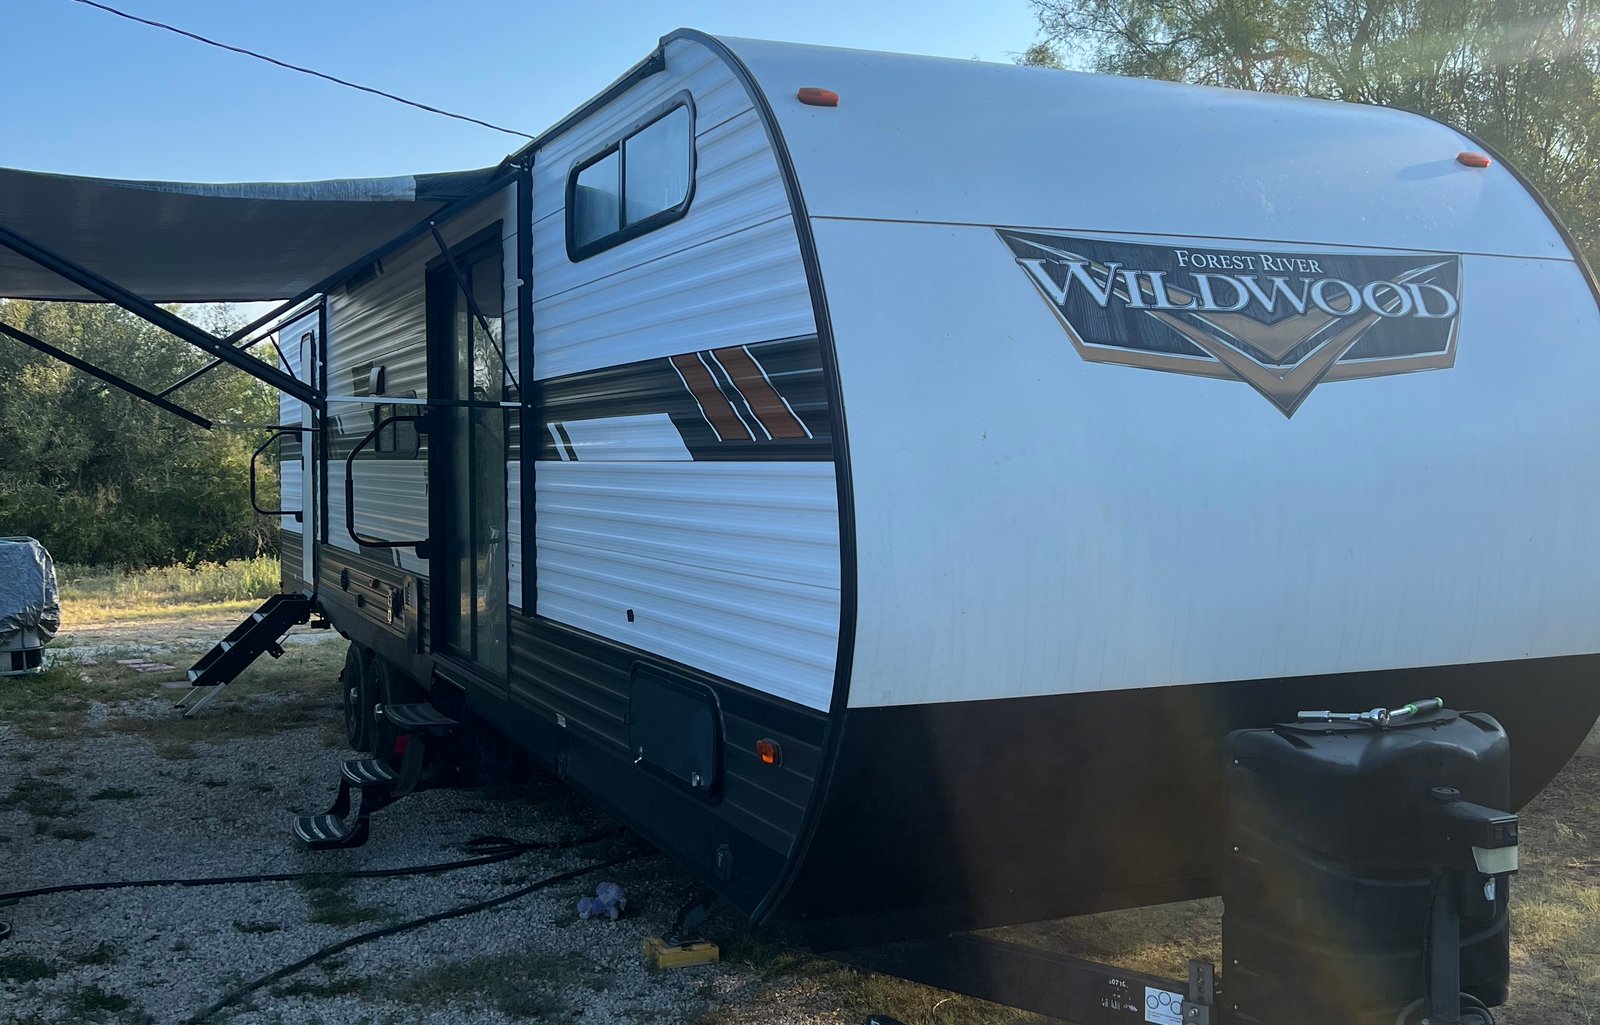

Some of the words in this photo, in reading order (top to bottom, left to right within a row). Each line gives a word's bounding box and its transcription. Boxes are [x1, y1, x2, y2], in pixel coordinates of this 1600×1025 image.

[1174, 250, 1255, 270] FOREST
[1259, 254, 1324, 273] RIVER
[1015, 257, 1458, 318] WILDWOOD
